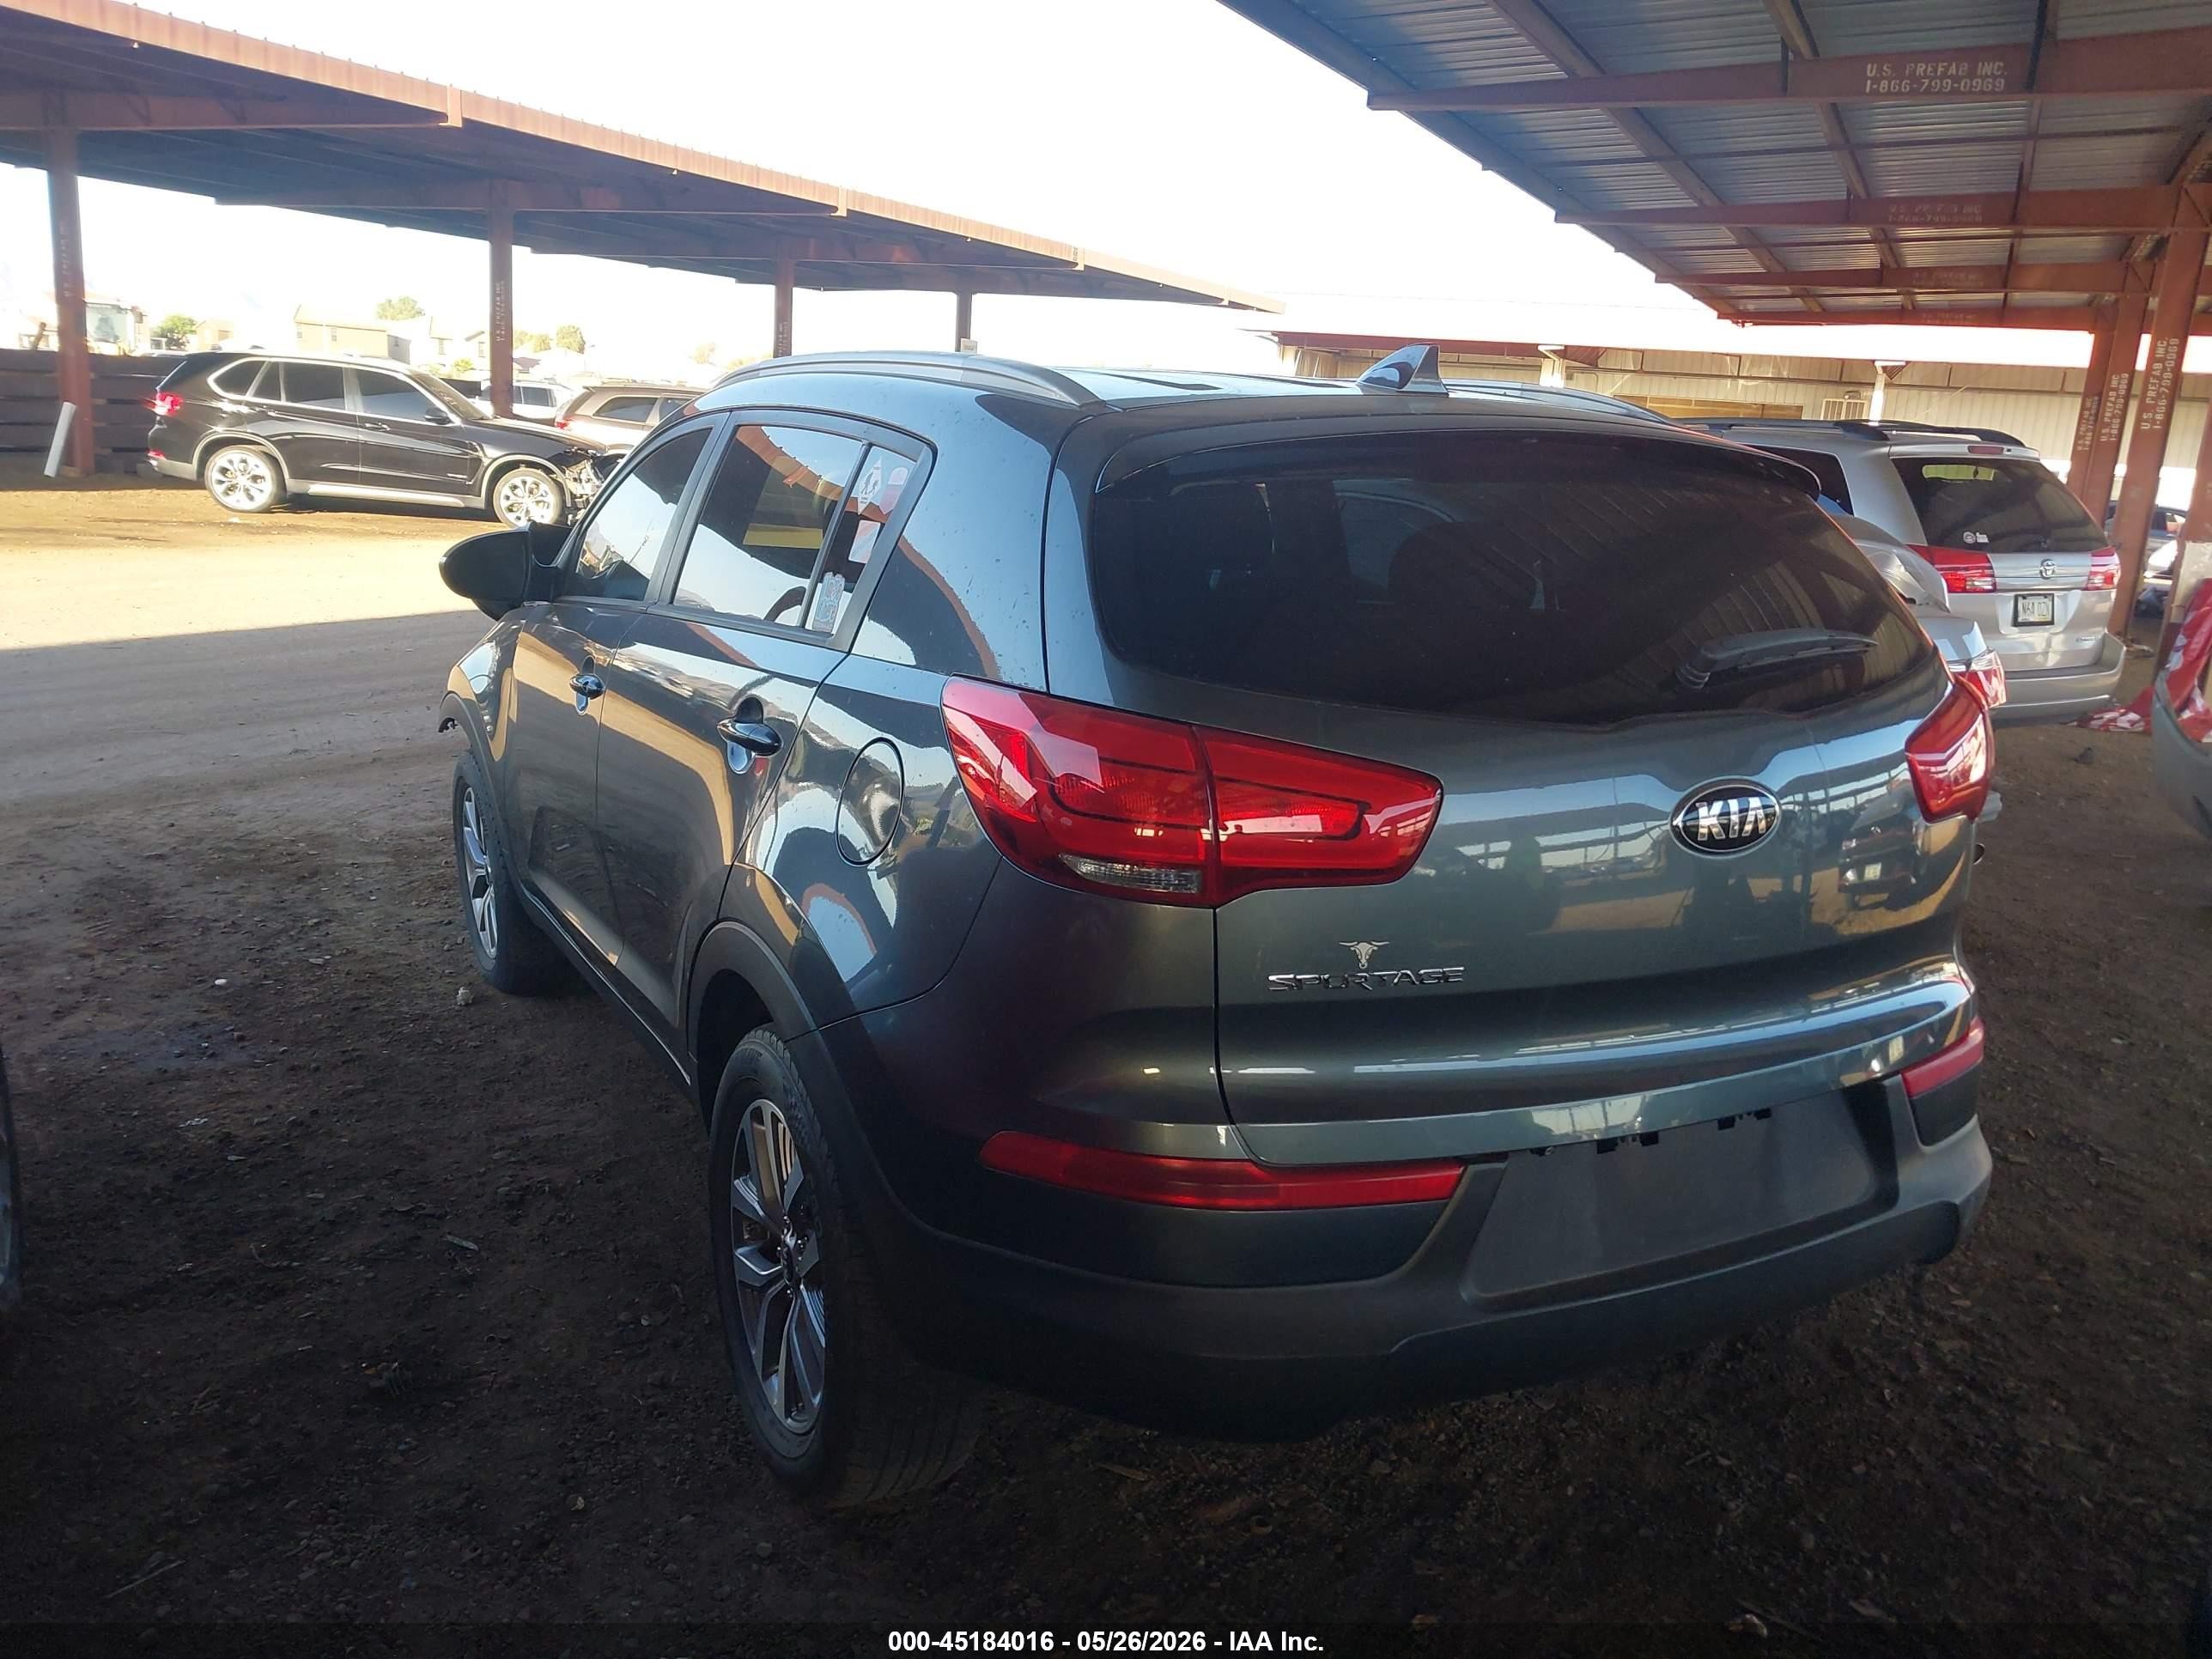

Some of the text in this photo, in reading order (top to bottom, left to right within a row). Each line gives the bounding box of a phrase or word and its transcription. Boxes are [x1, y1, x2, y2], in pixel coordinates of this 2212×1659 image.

[1905, 62, 1969, 77] PREFAB
[1978, 61, 2008, 76] INC.
[1865, 78, 2006, 94] 1-866-799-0969
[2146, 362, 2163, 404] PREFAB
[1695, 796, 1766, 842] KIA
[1267, 966, 1465, 991] SPORTAGE
